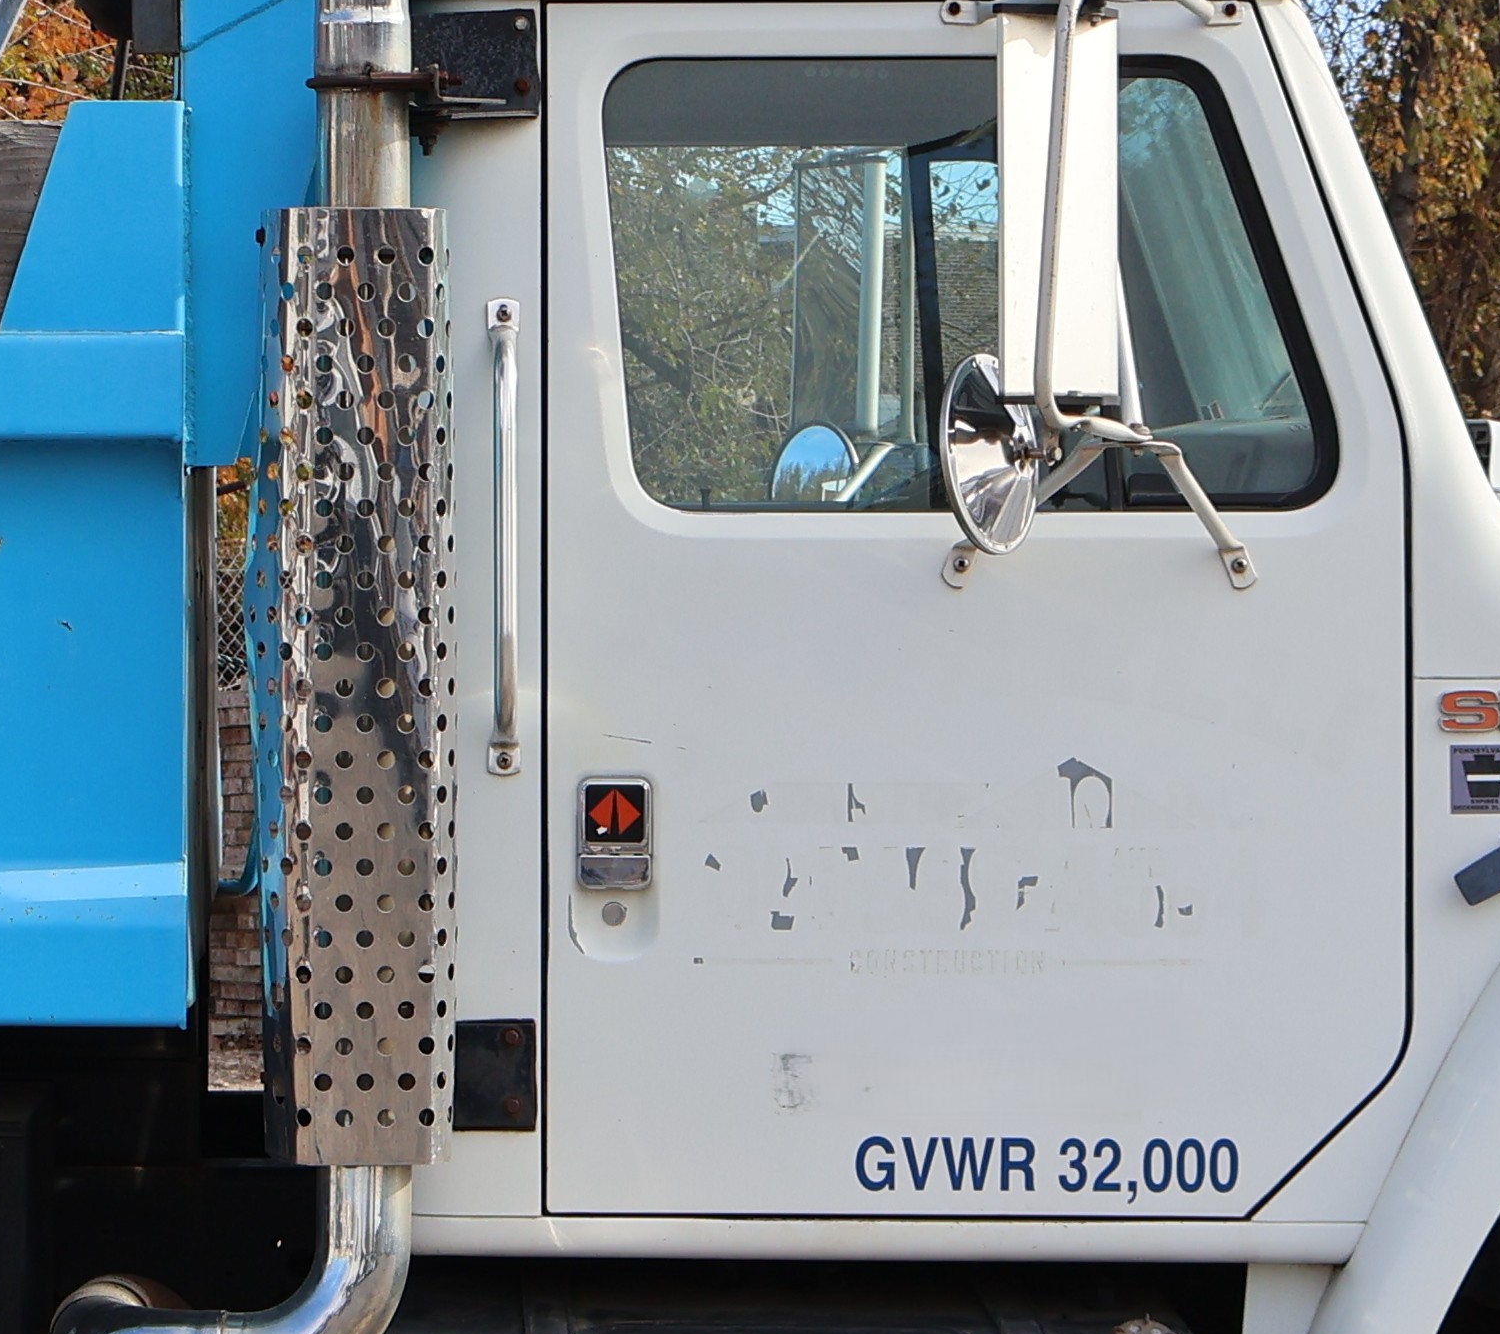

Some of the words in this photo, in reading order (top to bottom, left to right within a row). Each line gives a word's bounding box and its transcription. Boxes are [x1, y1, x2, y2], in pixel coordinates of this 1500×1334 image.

[1440, 690, 1500, 732] S
[855, 1135, 1036, 1192] GVWR
[1058, 1137, 1239, 1204] 32,000
